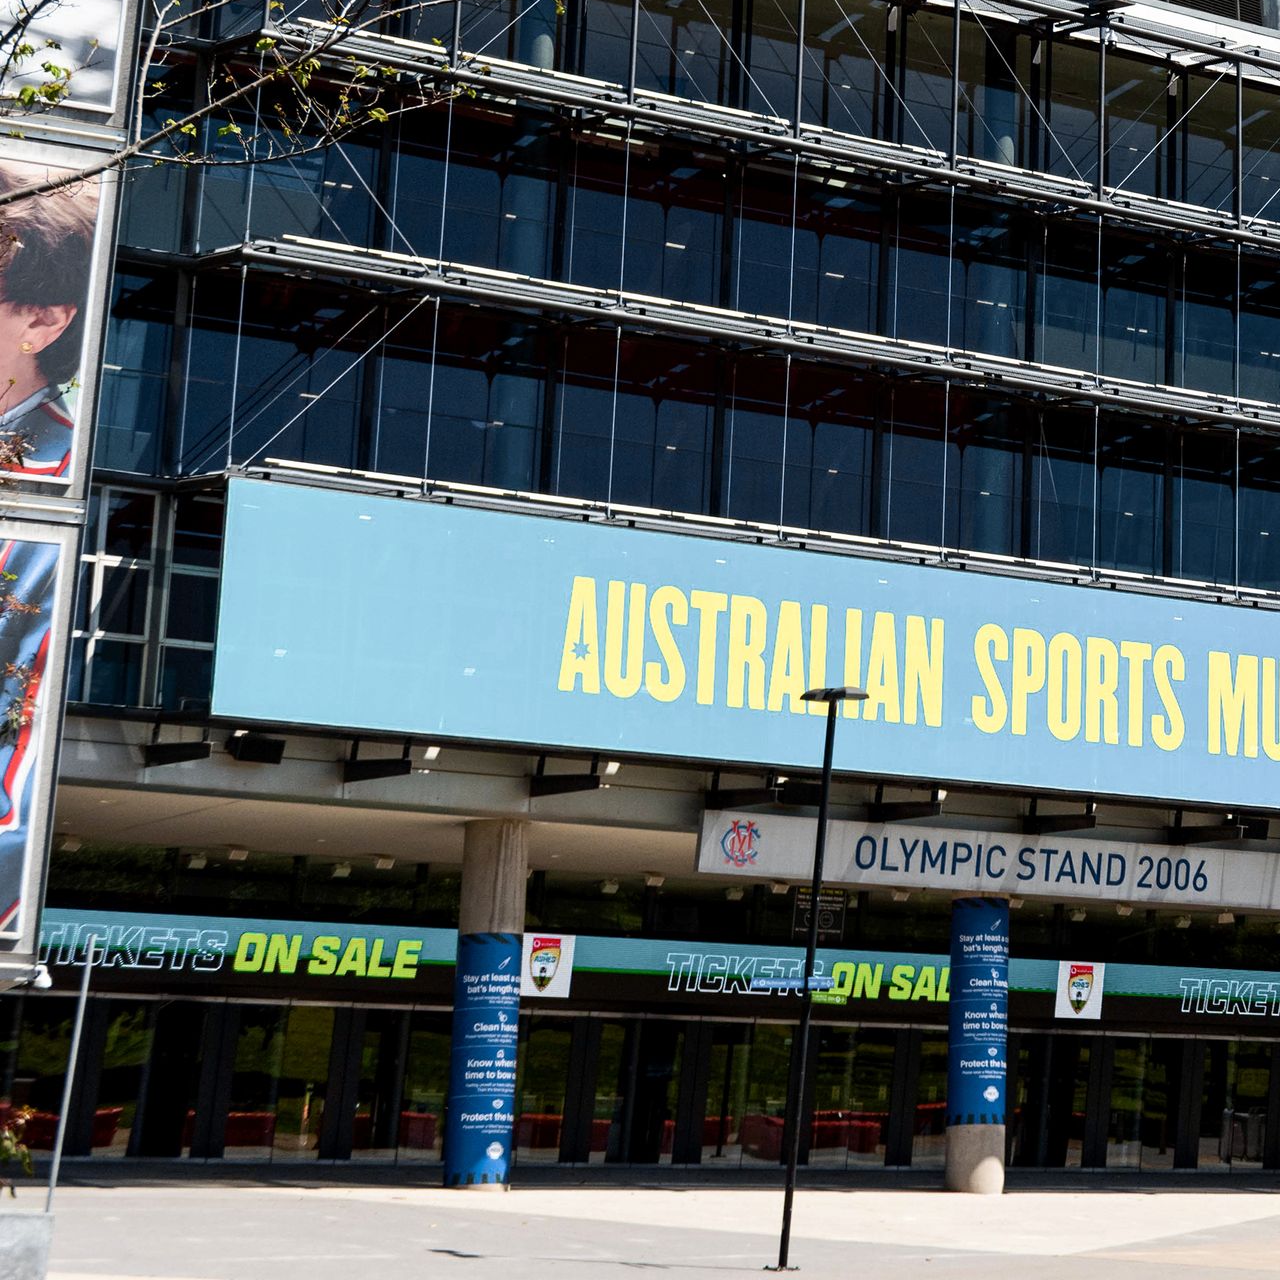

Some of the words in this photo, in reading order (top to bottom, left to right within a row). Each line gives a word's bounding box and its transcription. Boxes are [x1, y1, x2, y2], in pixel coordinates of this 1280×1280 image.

[558, 576, 944, 727] AUSTRALIAN
[971, 623, 1186, 752] SPORTS
[855, 835, 1007, 879] OLYMPIC
[1016, 847, 1127, 887] STAND
[1137, 856, 1208, 892] 2006
[959, 934, 974, 943] Stay
[975, 934, 983, 942] at
[984, 933, 1001, 942] least
[36, 922, 229, 971] TICKETS
[233, 931, 303, 974] ON
[306, 935, 423, 978] SALE
[463, 974, 480, 984] Stay
[481, 974, 490, 982] at
[491, 973, 510, 982] least
[829, 961, 885, 999] ON
[888, 965, 951, 1003] SAL
[970, 978, 992, 987] Clean
[489, 984, 513, 994] length
[965, 1011, 988, 1019] Know
[473, 1021, 500, 1032] Clean
[963, 1021, 980, 1030] time
[981, 1021, 990, 1030] to
[467, 1058, 494, 1068] Know
[960, 1059, 988, 1068] Protect
[465, 1070, 485, 1080] time
[486, 1070, 496, 1080] to
[460, 1113, 493, 1122] Protect
